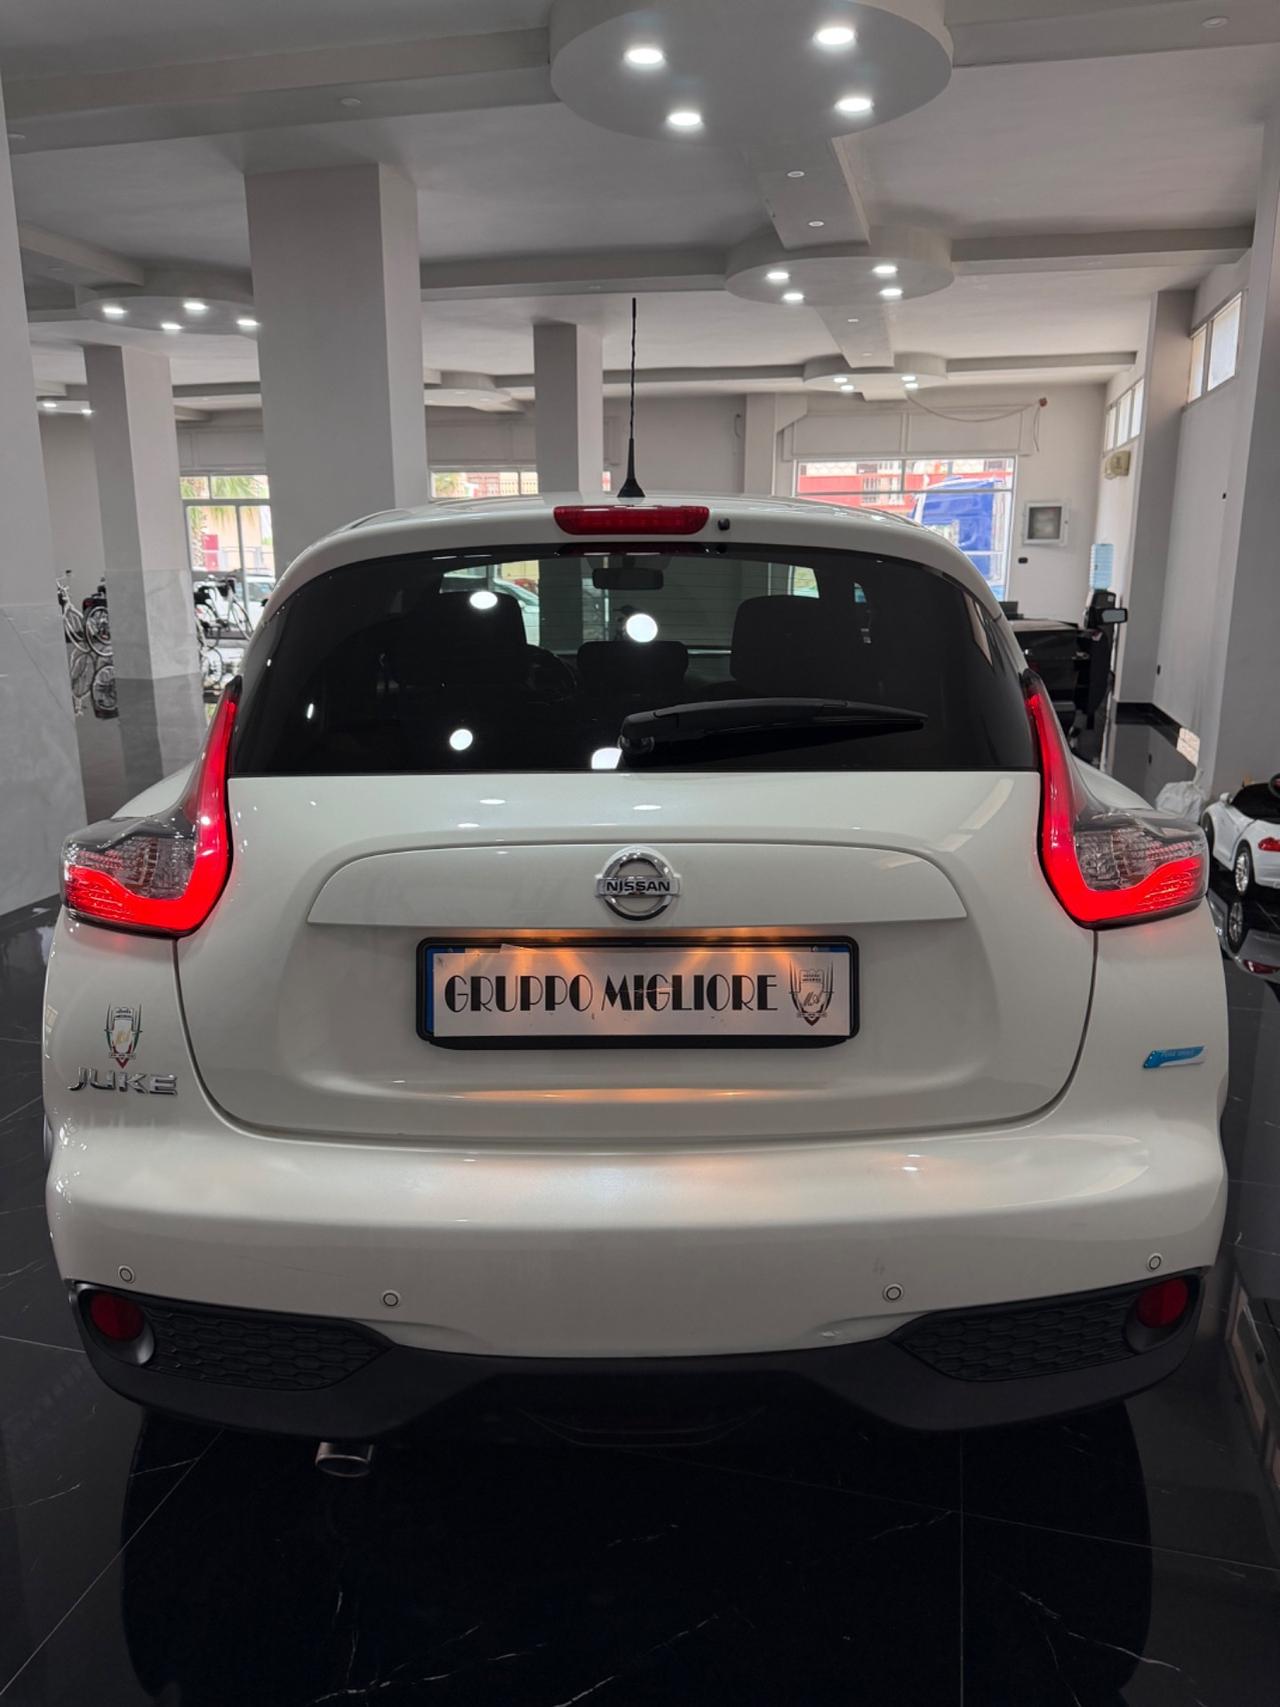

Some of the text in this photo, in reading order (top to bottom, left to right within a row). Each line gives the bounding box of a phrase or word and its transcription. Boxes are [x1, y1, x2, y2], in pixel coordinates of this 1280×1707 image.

[606, 881, 671, 893] NISSAN
[445, 974, 778, 1012] GRUPPO MIGLIORE
[67, 1066, 177, 1095] JUKE
